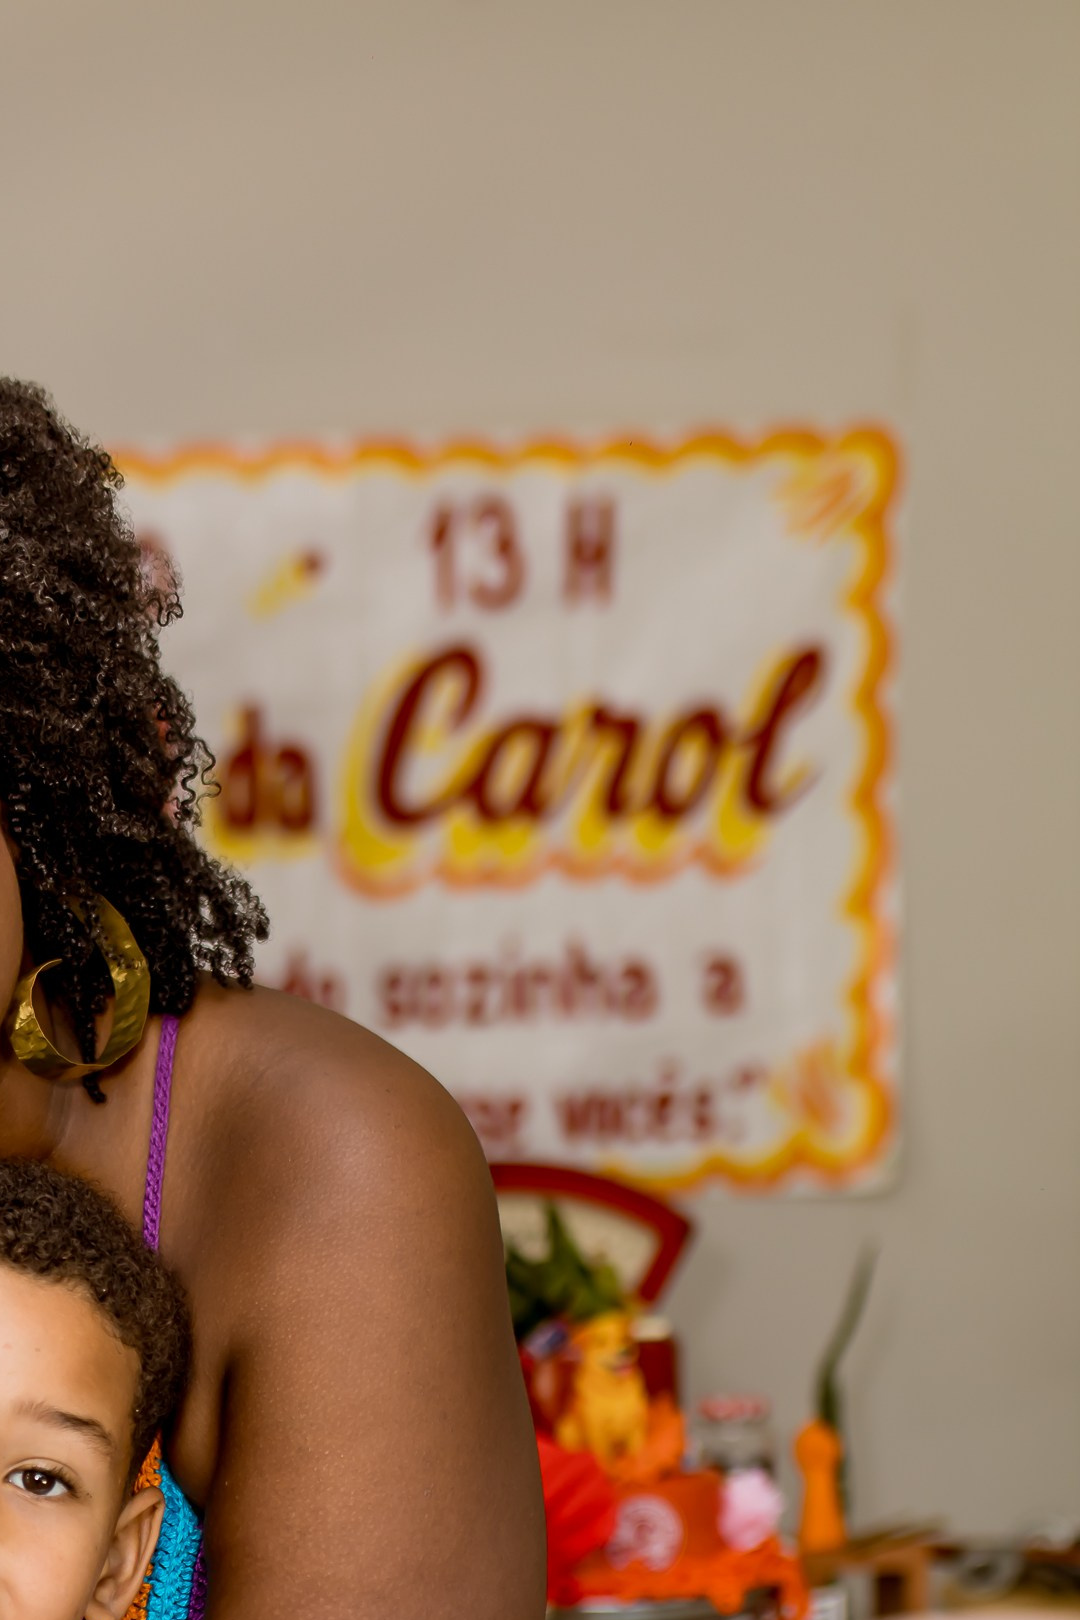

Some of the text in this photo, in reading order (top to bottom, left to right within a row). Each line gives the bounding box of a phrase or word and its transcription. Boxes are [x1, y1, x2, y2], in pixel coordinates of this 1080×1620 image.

[428, 495, 617, 614] 13 H
[358, 640, 828, 840] Carol
